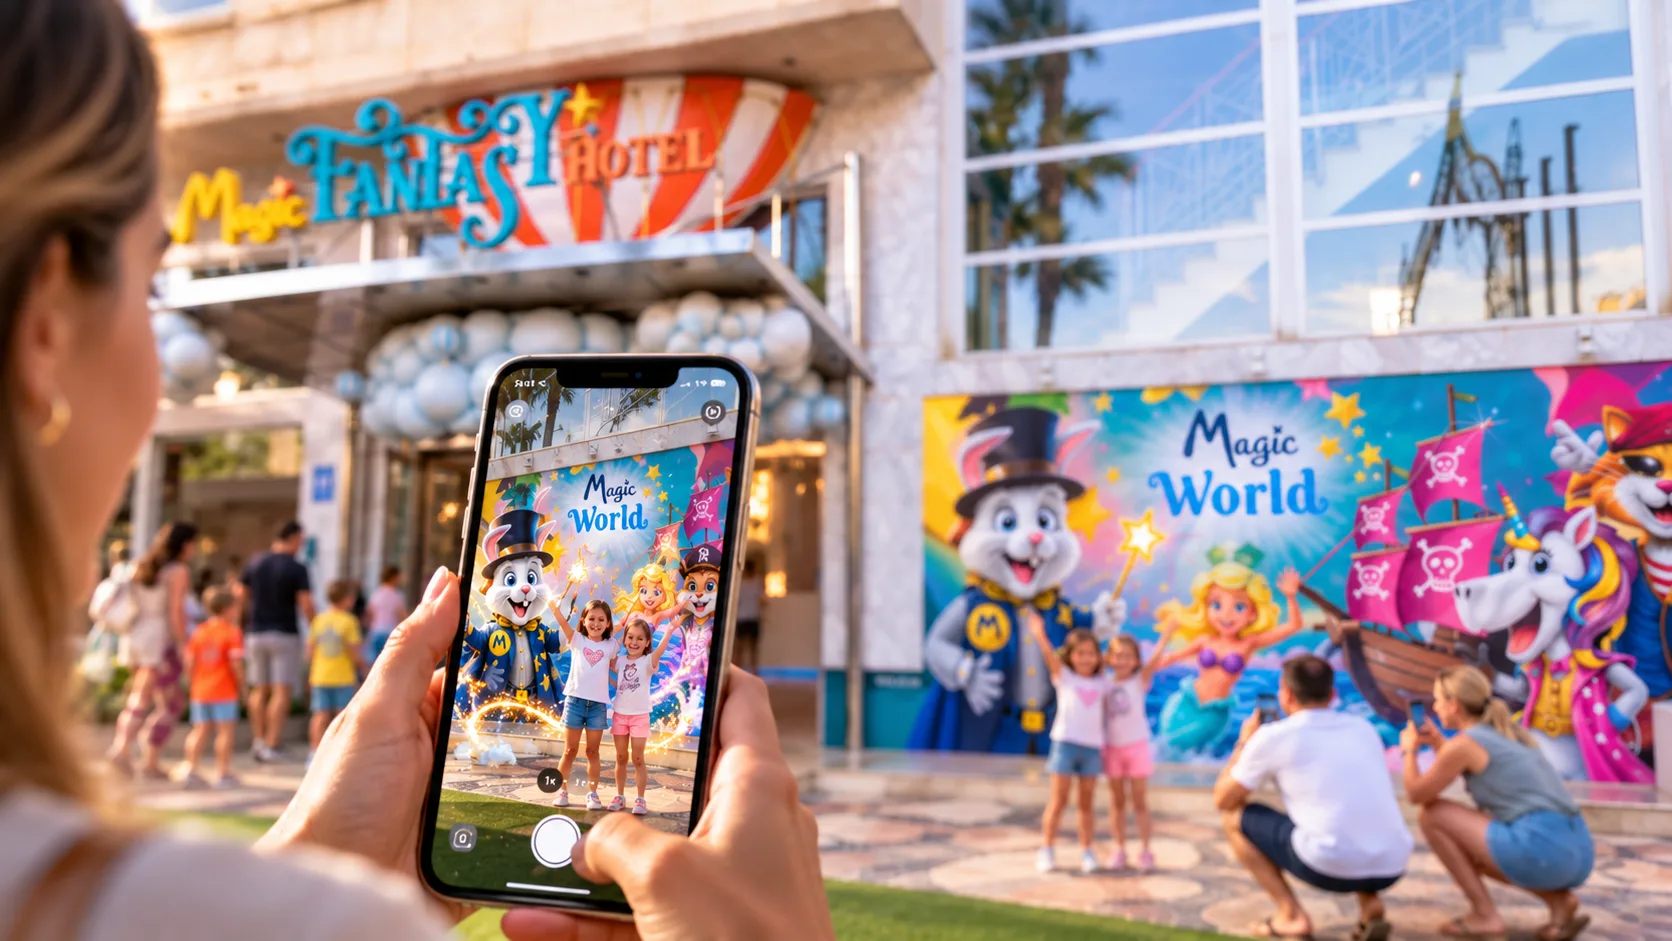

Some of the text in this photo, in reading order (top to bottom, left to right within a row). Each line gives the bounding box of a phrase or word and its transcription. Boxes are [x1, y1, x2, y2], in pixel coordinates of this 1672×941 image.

[171, 88, 716, 249] Magic FANTASY HOTEL
[1183, 408, 1298, 468] Magic
[583, 473, 637, 504] Magic
[1148, 468, 1329, 517] World
[567, 503, 649, 533] World
[492, 632, 506, 649] M
[977, 614, 1002, 640] M
